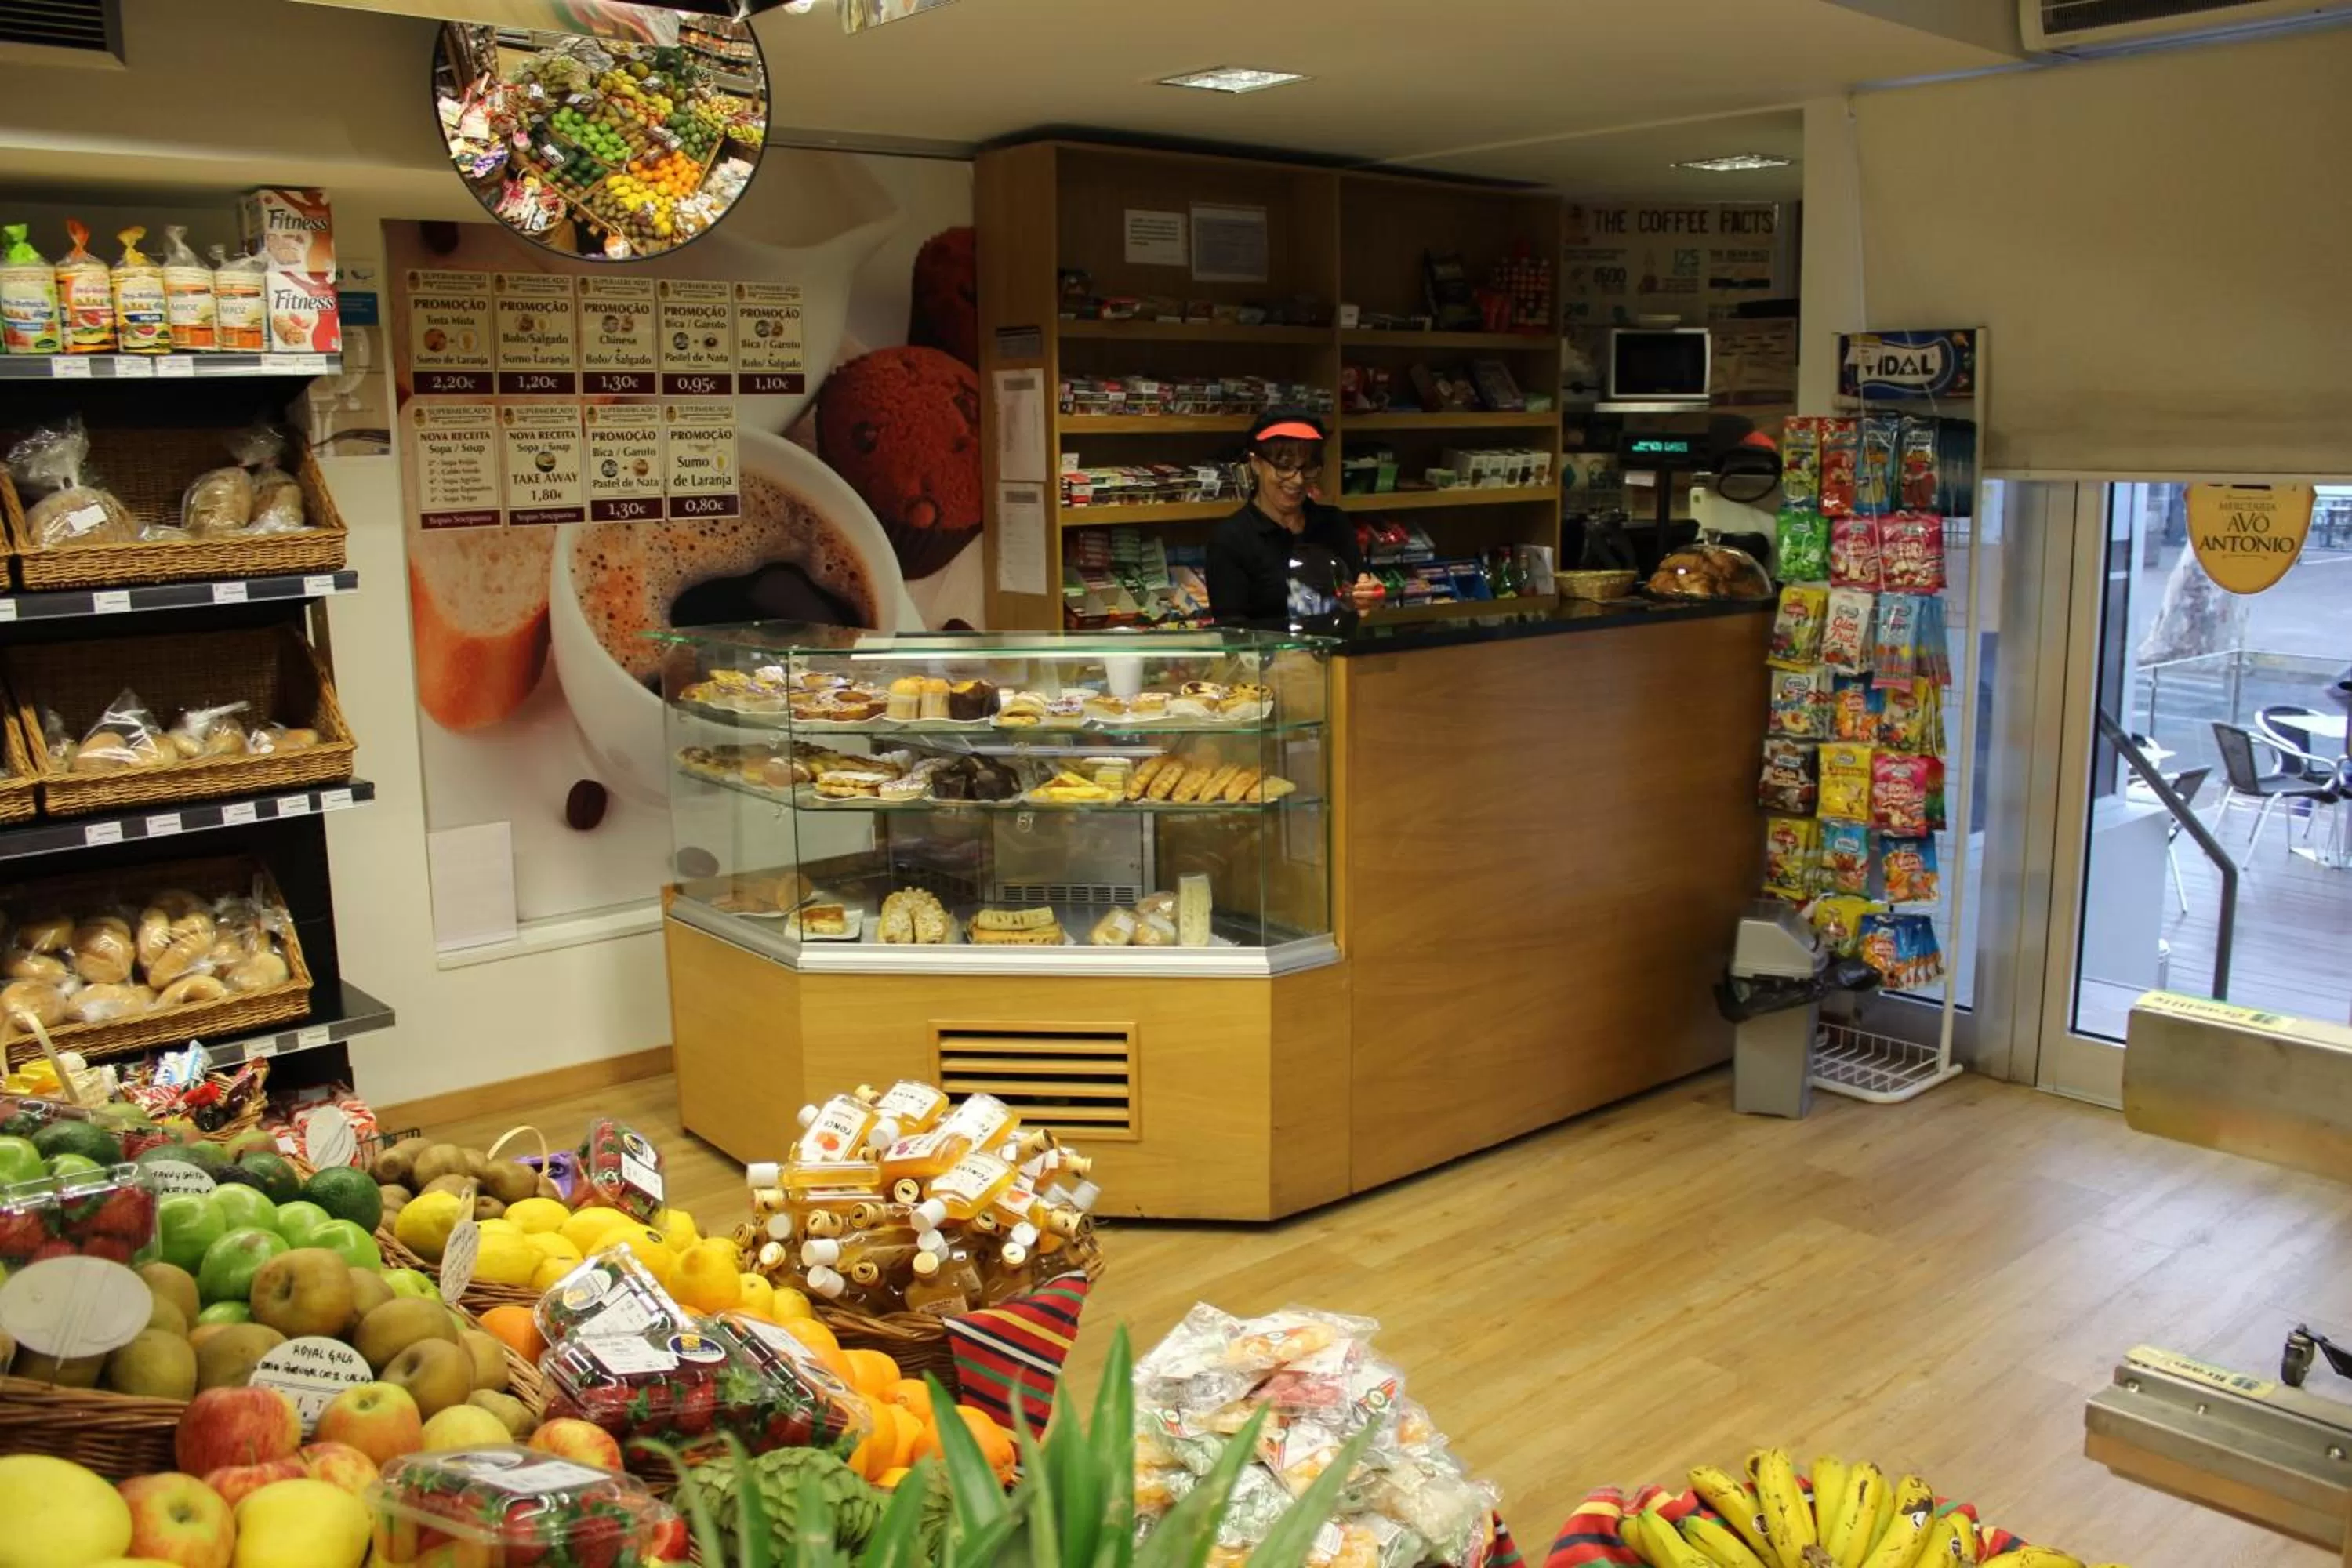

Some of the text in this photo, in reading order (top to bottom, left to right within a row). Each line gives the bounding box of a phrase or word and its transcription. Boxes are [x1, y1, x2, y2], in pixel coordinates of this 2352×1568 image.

[269, 209, 328, 230] Fitness
[1592, 210, 1774, 234] THE COFFEE FACTS
[275, 289, 336, 311] Fitness
[414, 298, 486, 312] PROMOÇÃO
[500, 300, 568, 313] PROMOÇÃO
[584, 303, 650, 314] PROMOÇÃO
[664, 305, 726, 318] PROMOÇÃO
[739, 307, 799, 320] PROMOÇÃO
[665, 320, 684, 328] Bica
[599, 334, 637, 346] Chinesa
[417, 354, 488, 367] Sumo de Laranja
[503, 354, 571, 366] Sumo Laranja
[665, 353, 728, 363] Pastel de Nata
[420, 431, 491, 441] NOVA RECEITA
[538, 431, 576, 440] RECEITA
[592, 430, 656, 441] PROMOÇÃO
[671, 428, 733, 441] PROMOÇÃO
[429, 445, 452, 454] Sopa
[461, 444, 485, 453] Soup
[517, 443, 539, 453] Sopa
[549, 442, 571, 452] Soup
[592, 447, 614, 456] Bica
[677, 456, 710, 468] Sumo
[512, 472, 578, 485] TAKE AWAY
[593, 477, 659, 488] Pastel de Nata
[674, 473, 731, 489] de Laranja
[293, 1345, 354, 1364] ROYAL GALA
